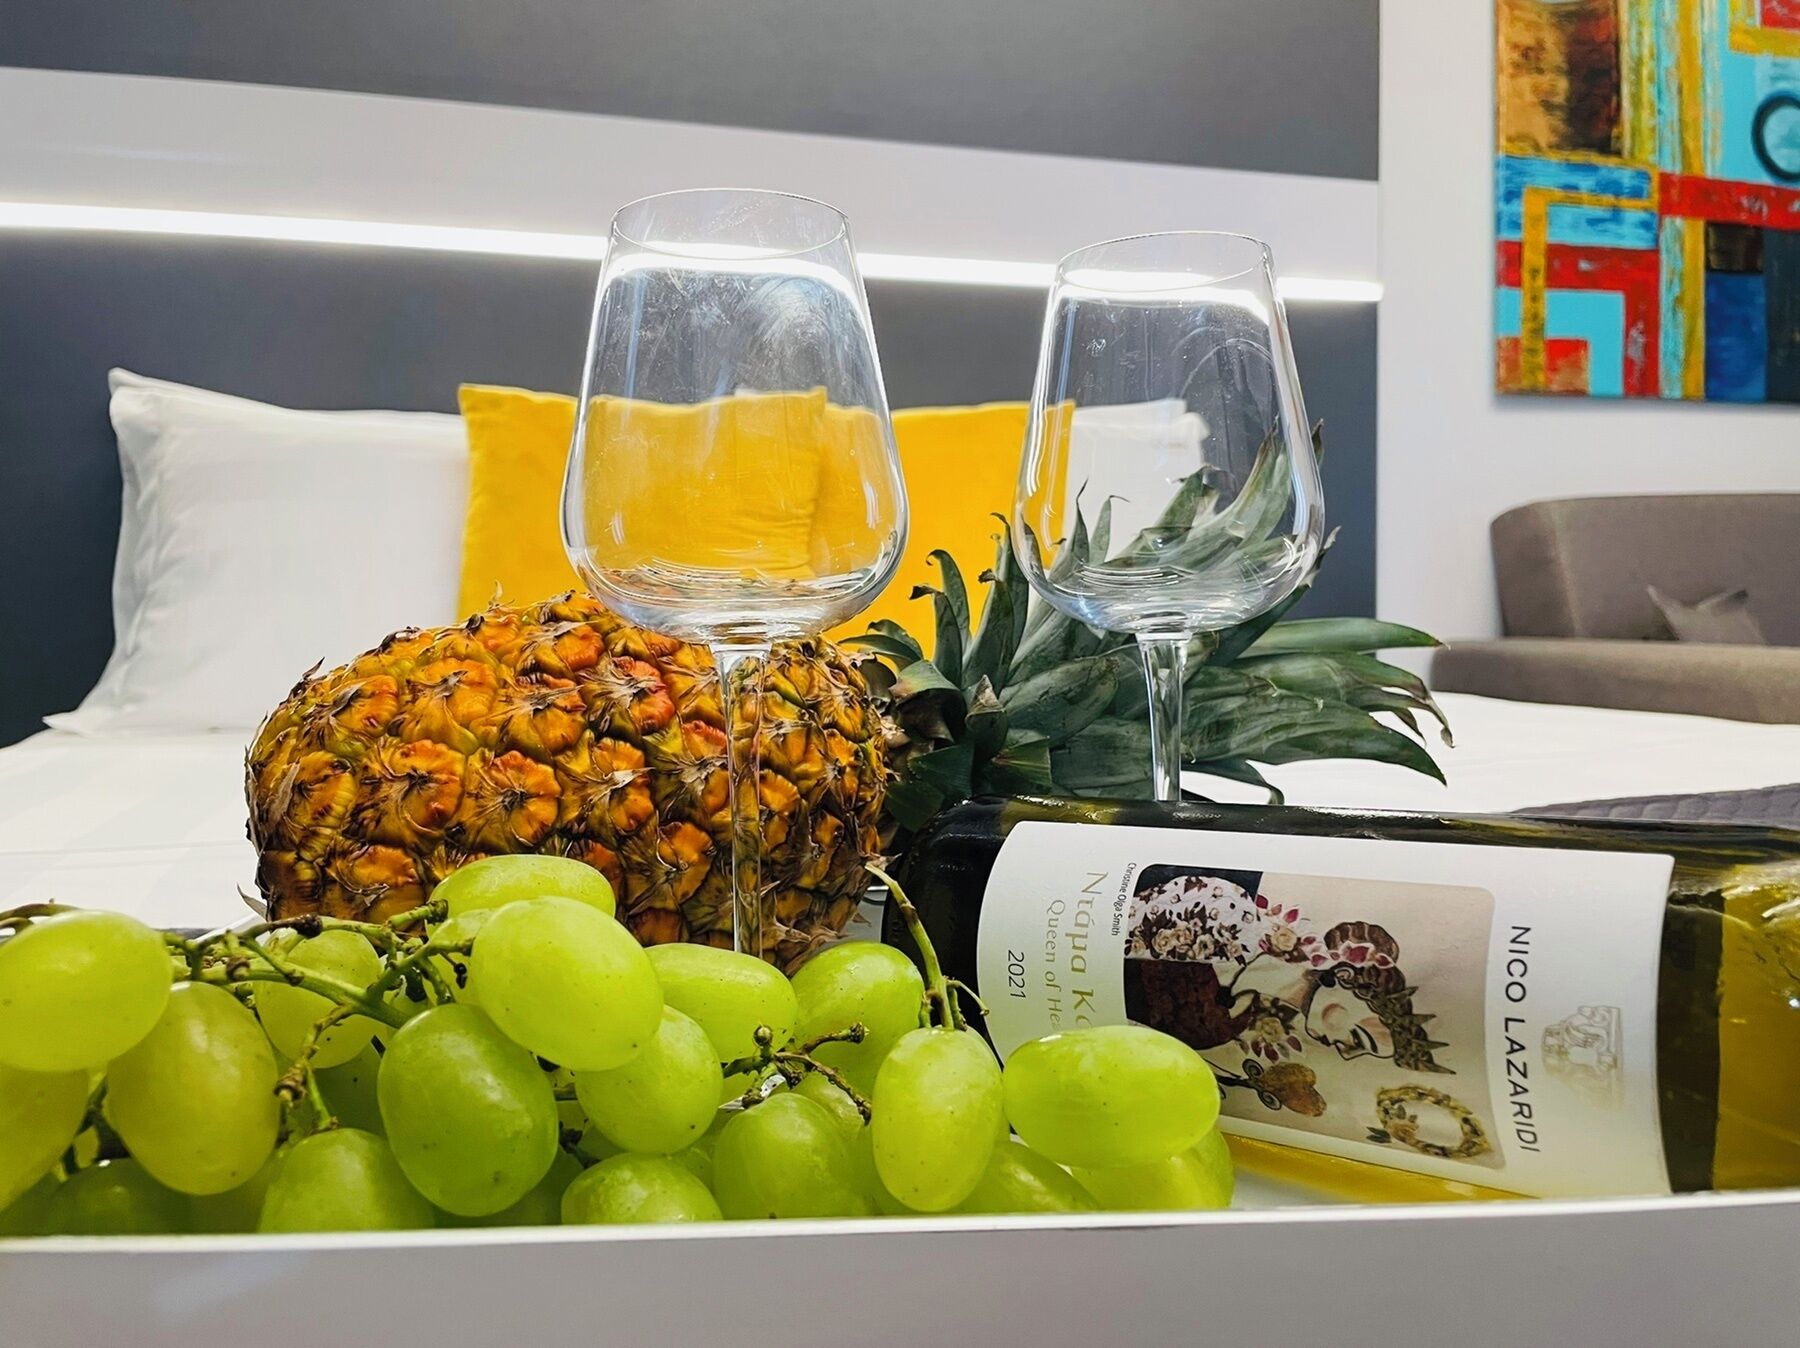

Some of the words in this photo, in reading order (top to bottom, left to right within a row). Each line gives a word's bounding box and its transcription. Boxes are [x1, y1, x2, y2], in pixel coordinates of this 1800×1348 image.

[1119, 862, 1137, 893] Christine
[1113, 894, 1127, 912] Olga
[1045, 899, 1065, 962] Queen
[1111, 913, 1123, 937] Smith
[1008, 949, 1026, 999] 2021
[1045, 971, 1062, 992] of
[1504, 926, 1532, 1003] NICO
[1504, 1016, 1541, 1152] LAZARIDI
